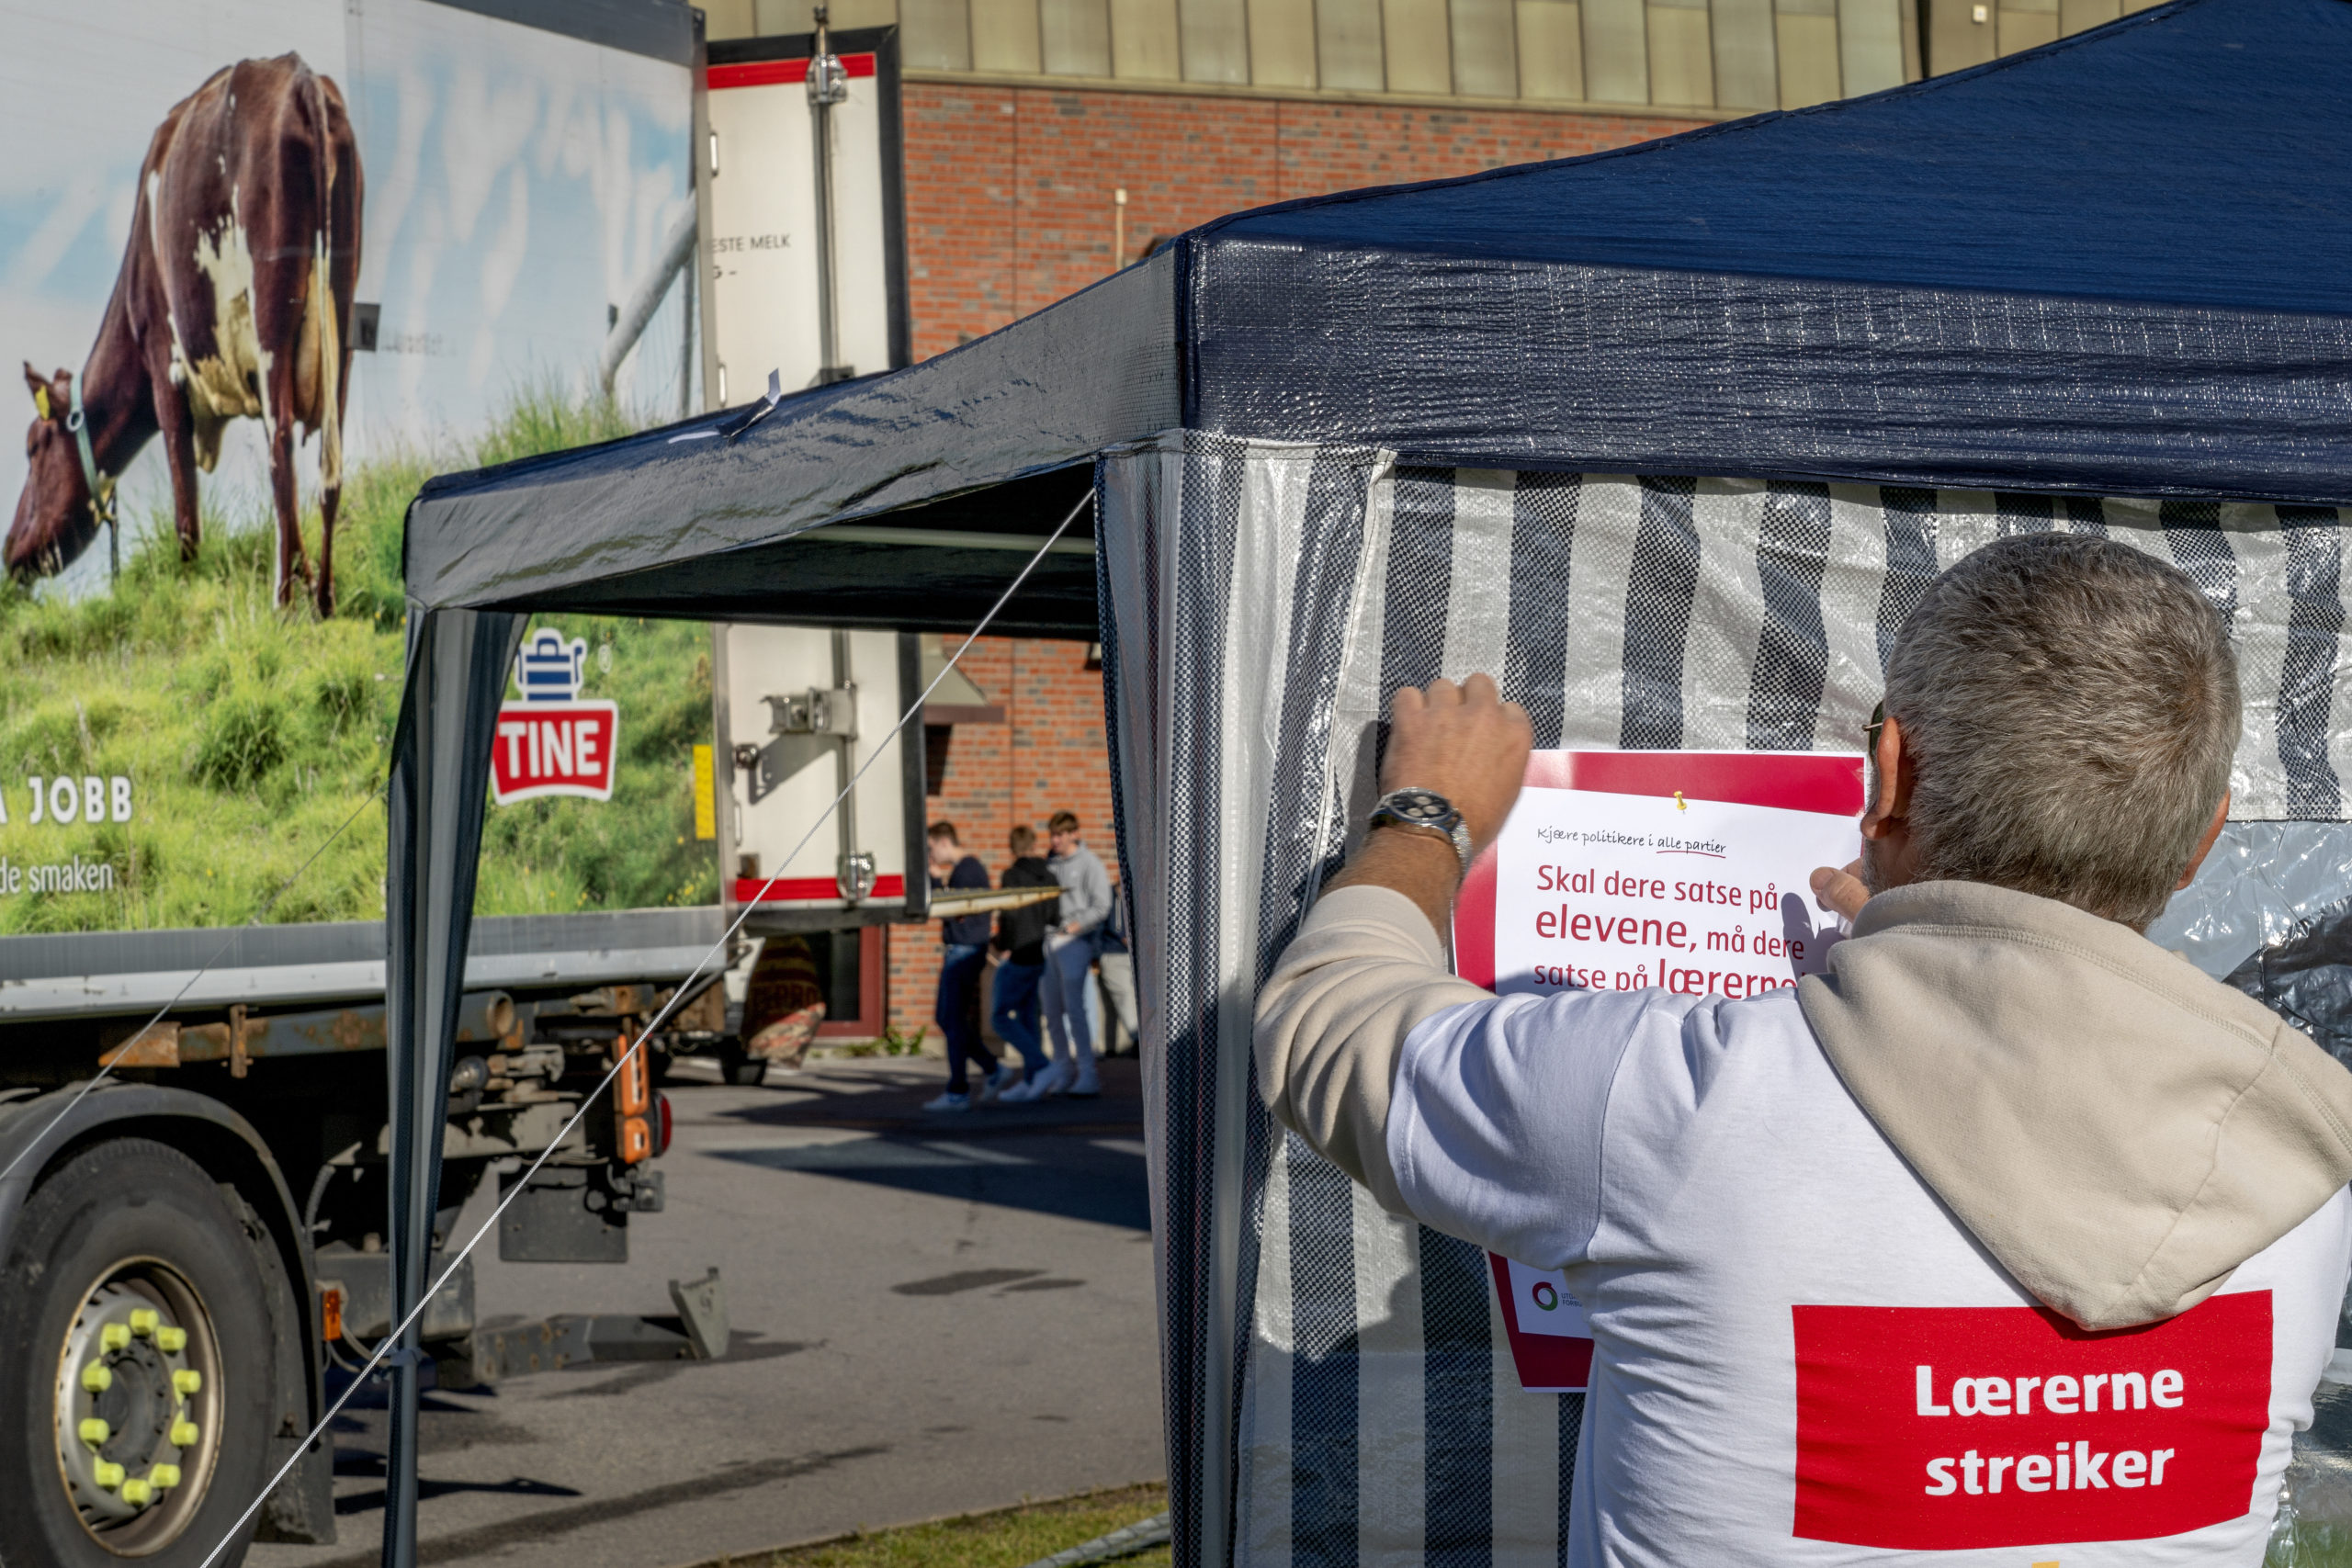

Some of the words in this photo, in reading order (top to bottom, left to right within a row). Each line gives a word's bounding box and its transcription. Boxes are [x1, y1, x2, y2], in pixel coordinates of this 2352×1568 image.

[750, 233, 792, 250] MELK
[498, 719, 602, 779] TINE
[28, 775, 132, 825] JOBB
[1537, 826, 1578, 844] Kjære
[1581, 829, 1645, 846] politikere
[1648, 834, 1654, 846] i
[1657, 837, 1681, 849] alle
[1685, 840, 1726, 854] partier
[28, 853, 114, 894] smaken
[1537, 864, 1595, 894] Skal
[1604, 870, 1666, 900] dere
[1674, 881, 1742, 907] satse
[1749, 882, 1778, 915] på
[1535, 903, 1697, 953] elevene,
[1707, 925, 1746, 953] må
[1753, 931, 1804, 960] dere
[1533, 964, 1606, 989] satse
[1615, 964, 1648, 992] på
[1658, 958, 1805, 999] lærern
[1916, 1365, 2185, 1416] Lærerne
[1925, 1440, 2176, 1496] streiker
